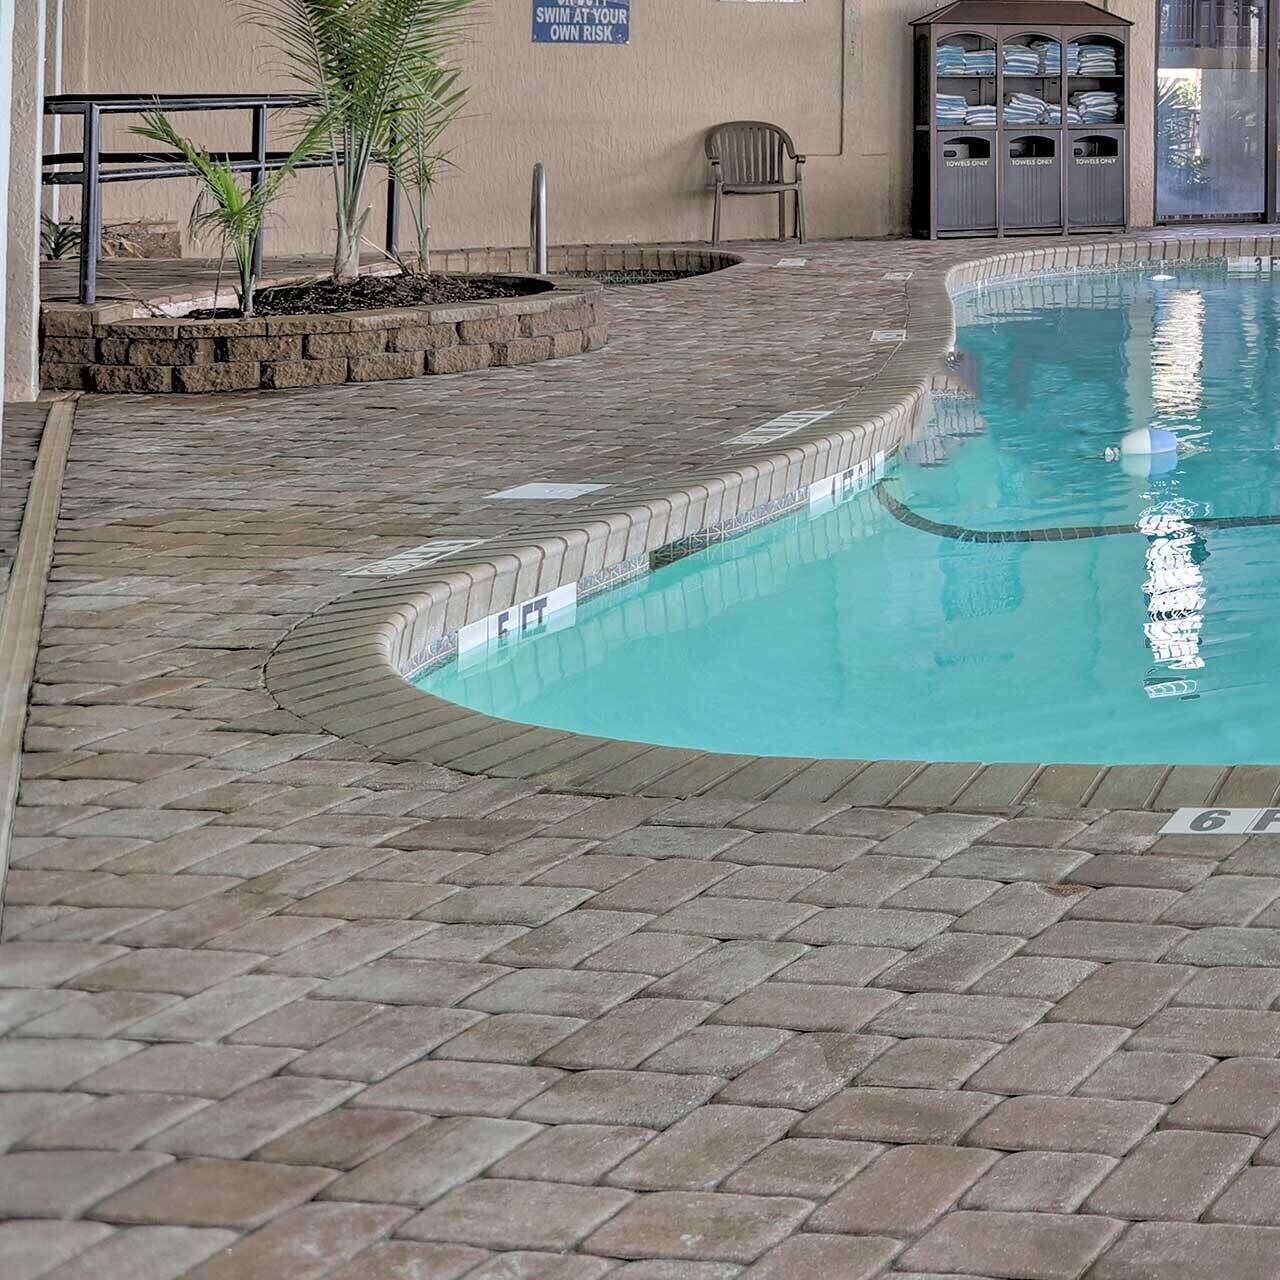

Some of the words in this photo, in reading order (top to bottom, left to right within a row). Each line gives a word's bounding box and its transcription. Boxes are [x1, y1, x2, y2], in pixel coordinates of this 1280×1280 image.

[536, 7, 570, 23] SWIM
[573, 8, 589, 23] AT
[593, 8, 627, 24] YOUR
[550, 24, 579, 41] OWN
[583, 25, 613, 41] RISK
[1254, 257, 1263, 273] 3
[521, 596, 548, 631] FT
[1189, 809, 1232, 832] 6
